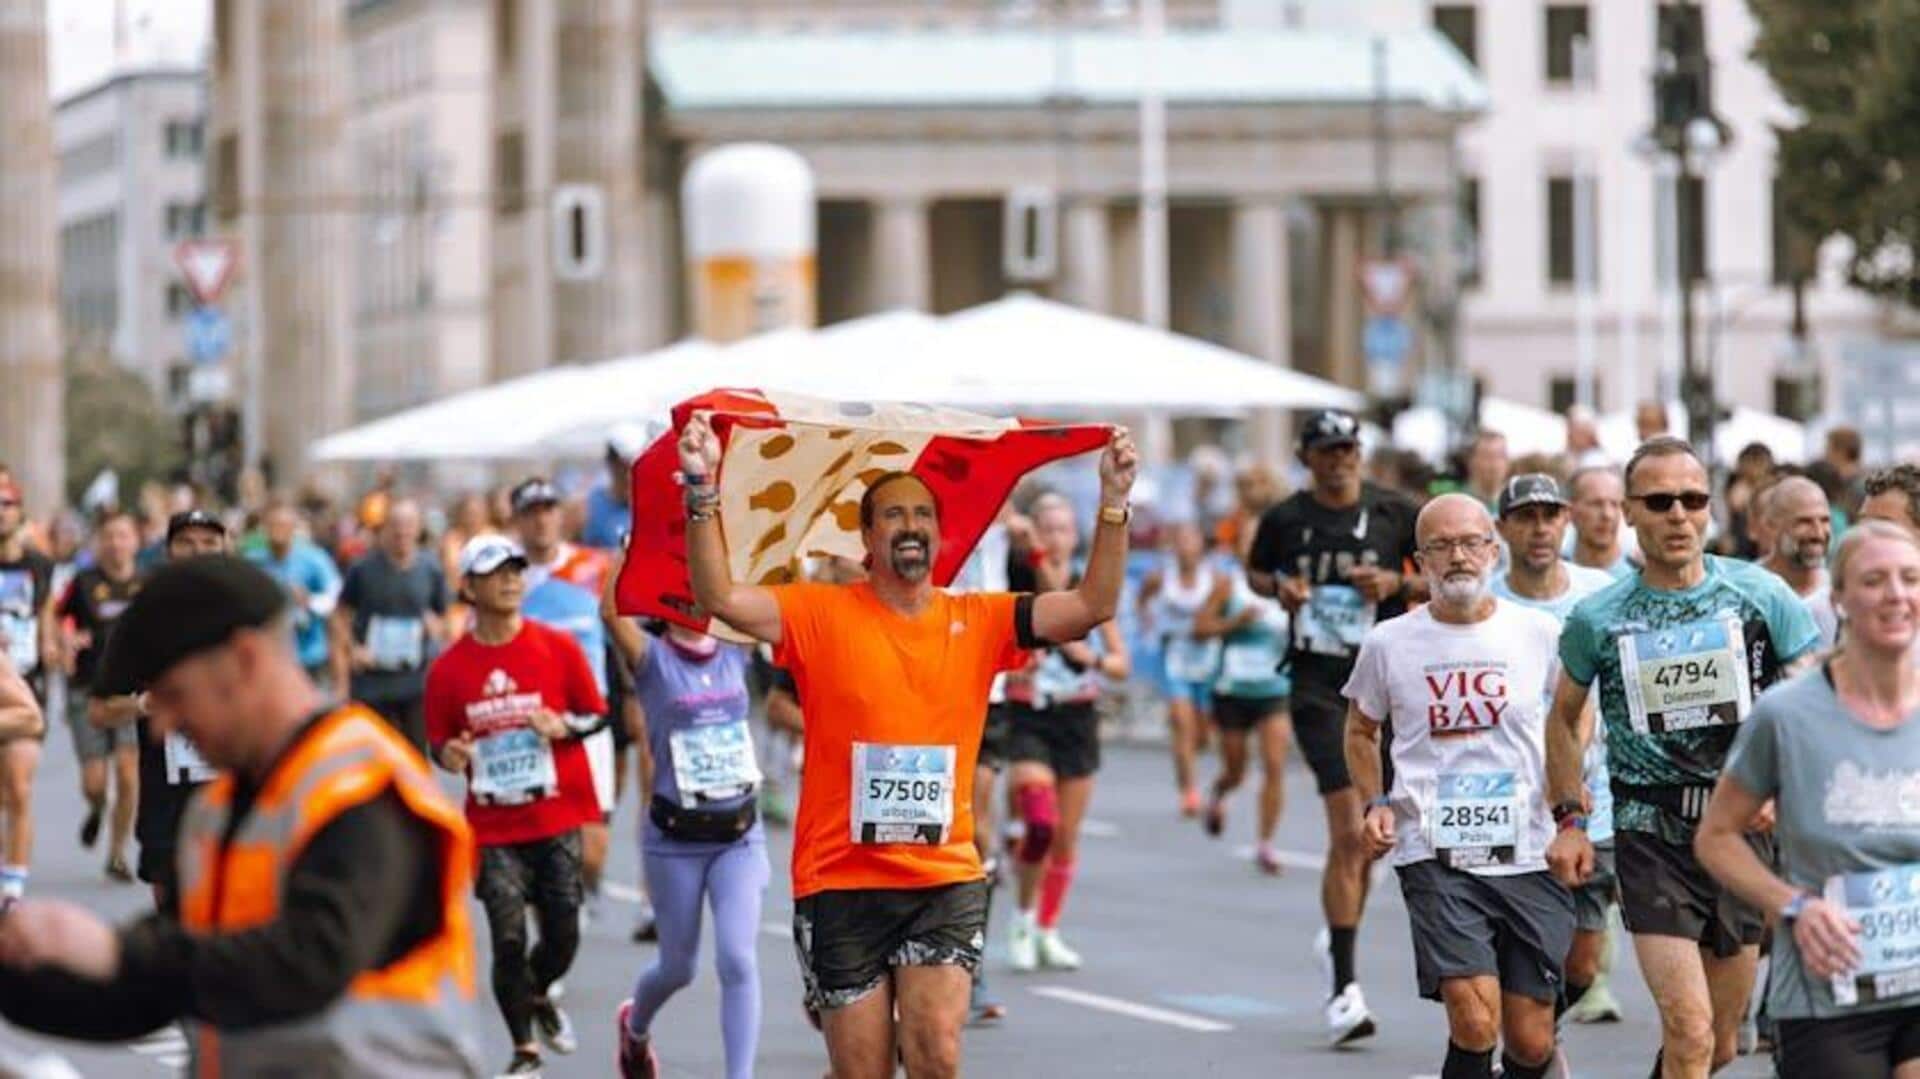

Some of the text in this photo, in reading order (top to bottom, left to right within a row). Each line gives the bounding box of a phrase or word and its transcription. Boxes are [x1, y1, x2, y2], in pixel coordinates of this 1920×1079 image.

[1426, 669, 1506, 700] VIG
[1654, 658, 1719, 688] 4794
[1428, 701, 1509, 728] BAY
[868, 778, 941, 802] 57508
[1440, 805, 1510, 827] 28541
